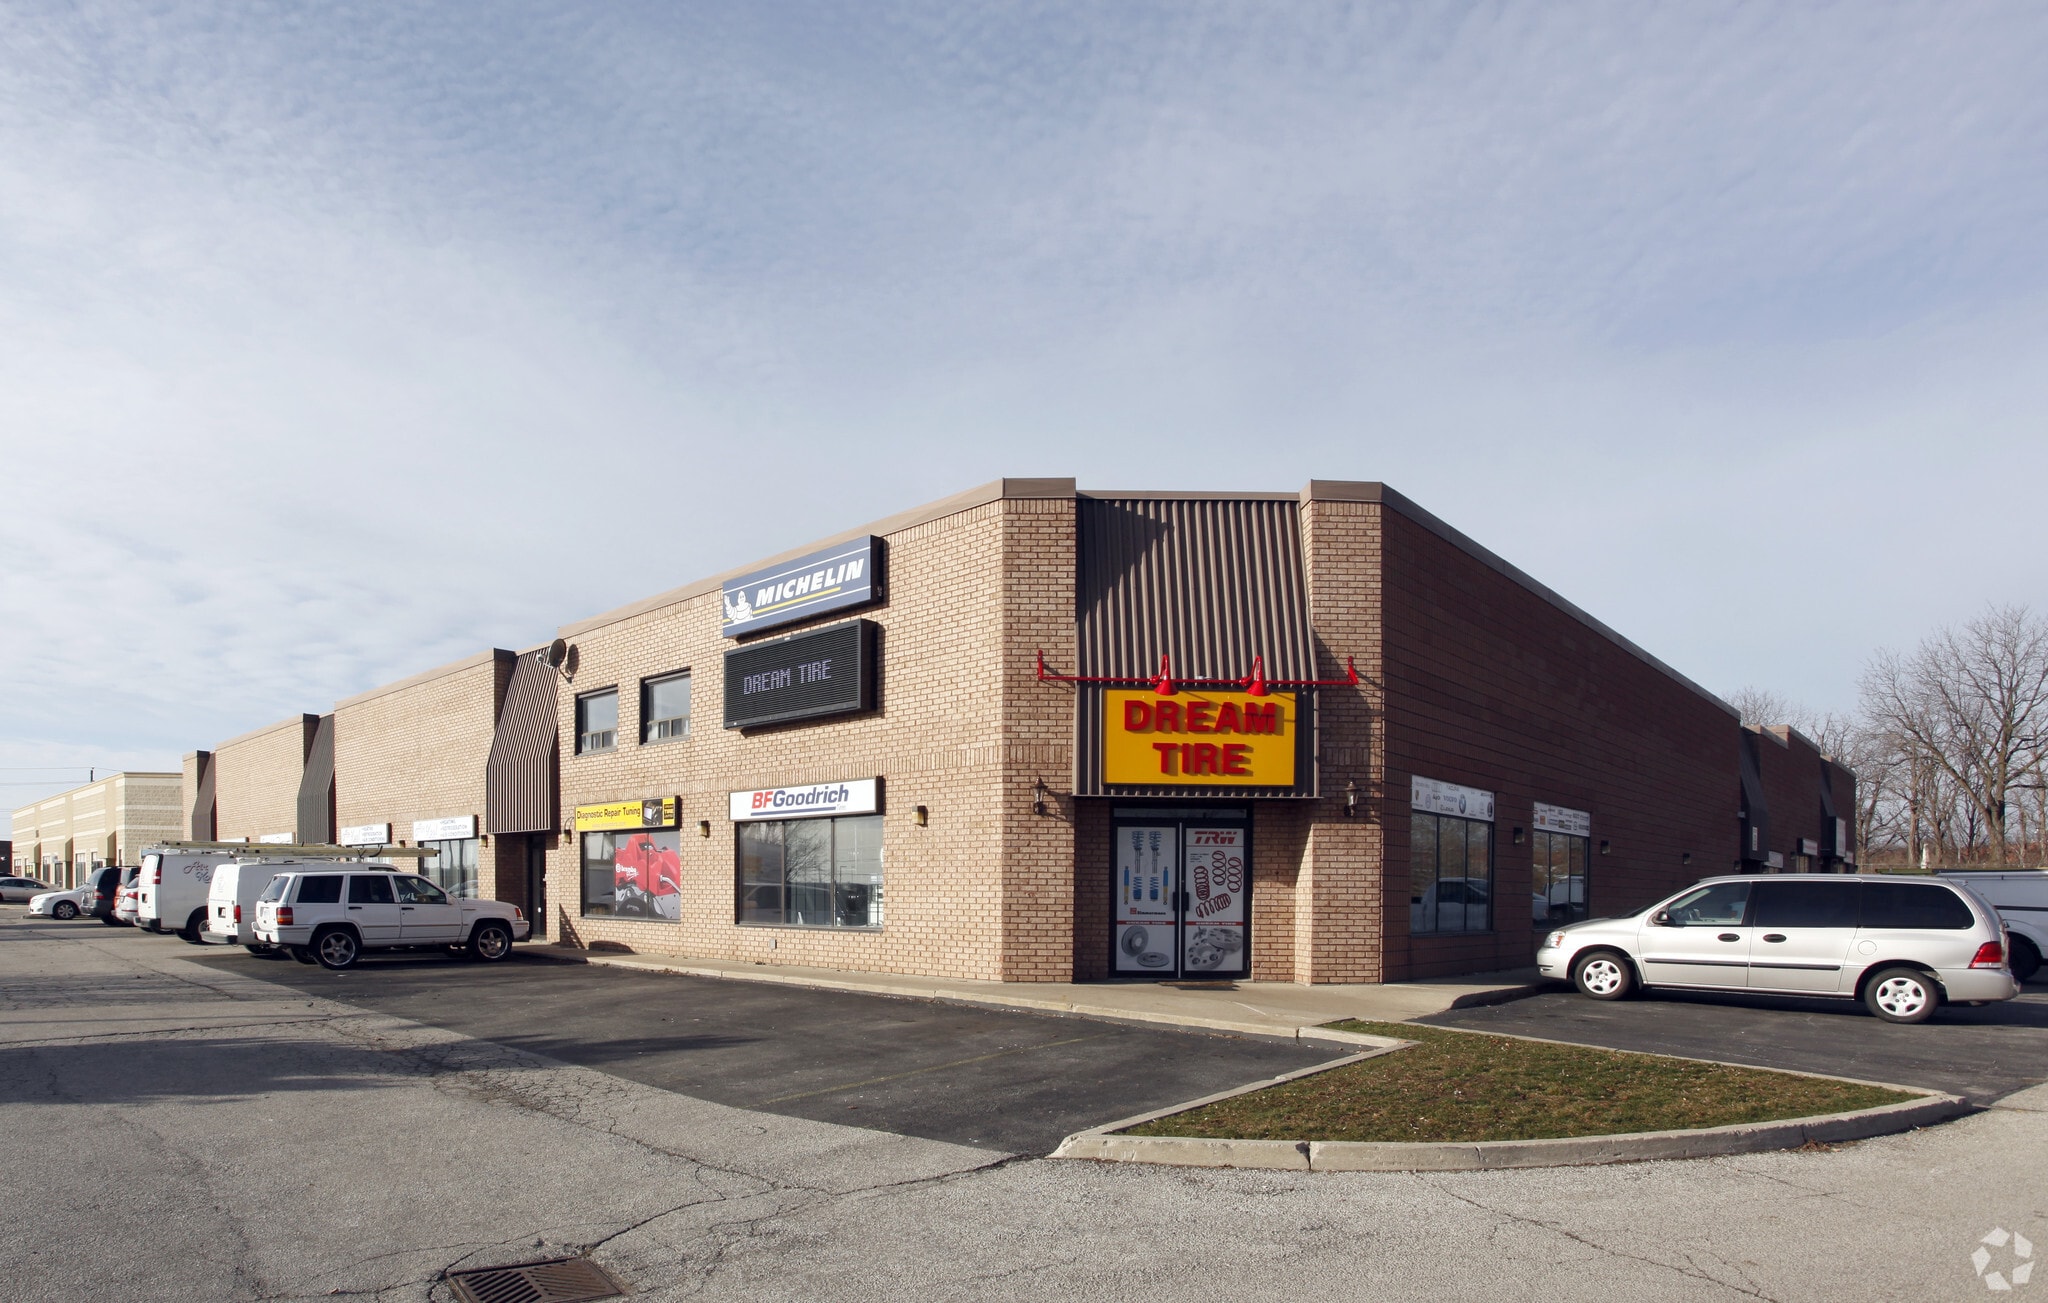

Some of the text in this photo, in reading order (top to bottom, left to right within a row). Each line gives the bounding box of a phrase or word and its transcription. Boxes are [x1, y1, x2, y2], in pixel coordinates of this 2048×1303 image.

[755, 558, 865, 607] MICHELIN
[743, 659, 832, 695] DREAM TIRE
[1124, 699, 1278, 734] DREAM
[1152, 742, 1247, 775] TIRE
[751, 784, 849, 809] BFGoodrich
[576, 806, 641, 821] Diagnostic Repair Tuning
[1194, 831, 1238, 844] TRW
